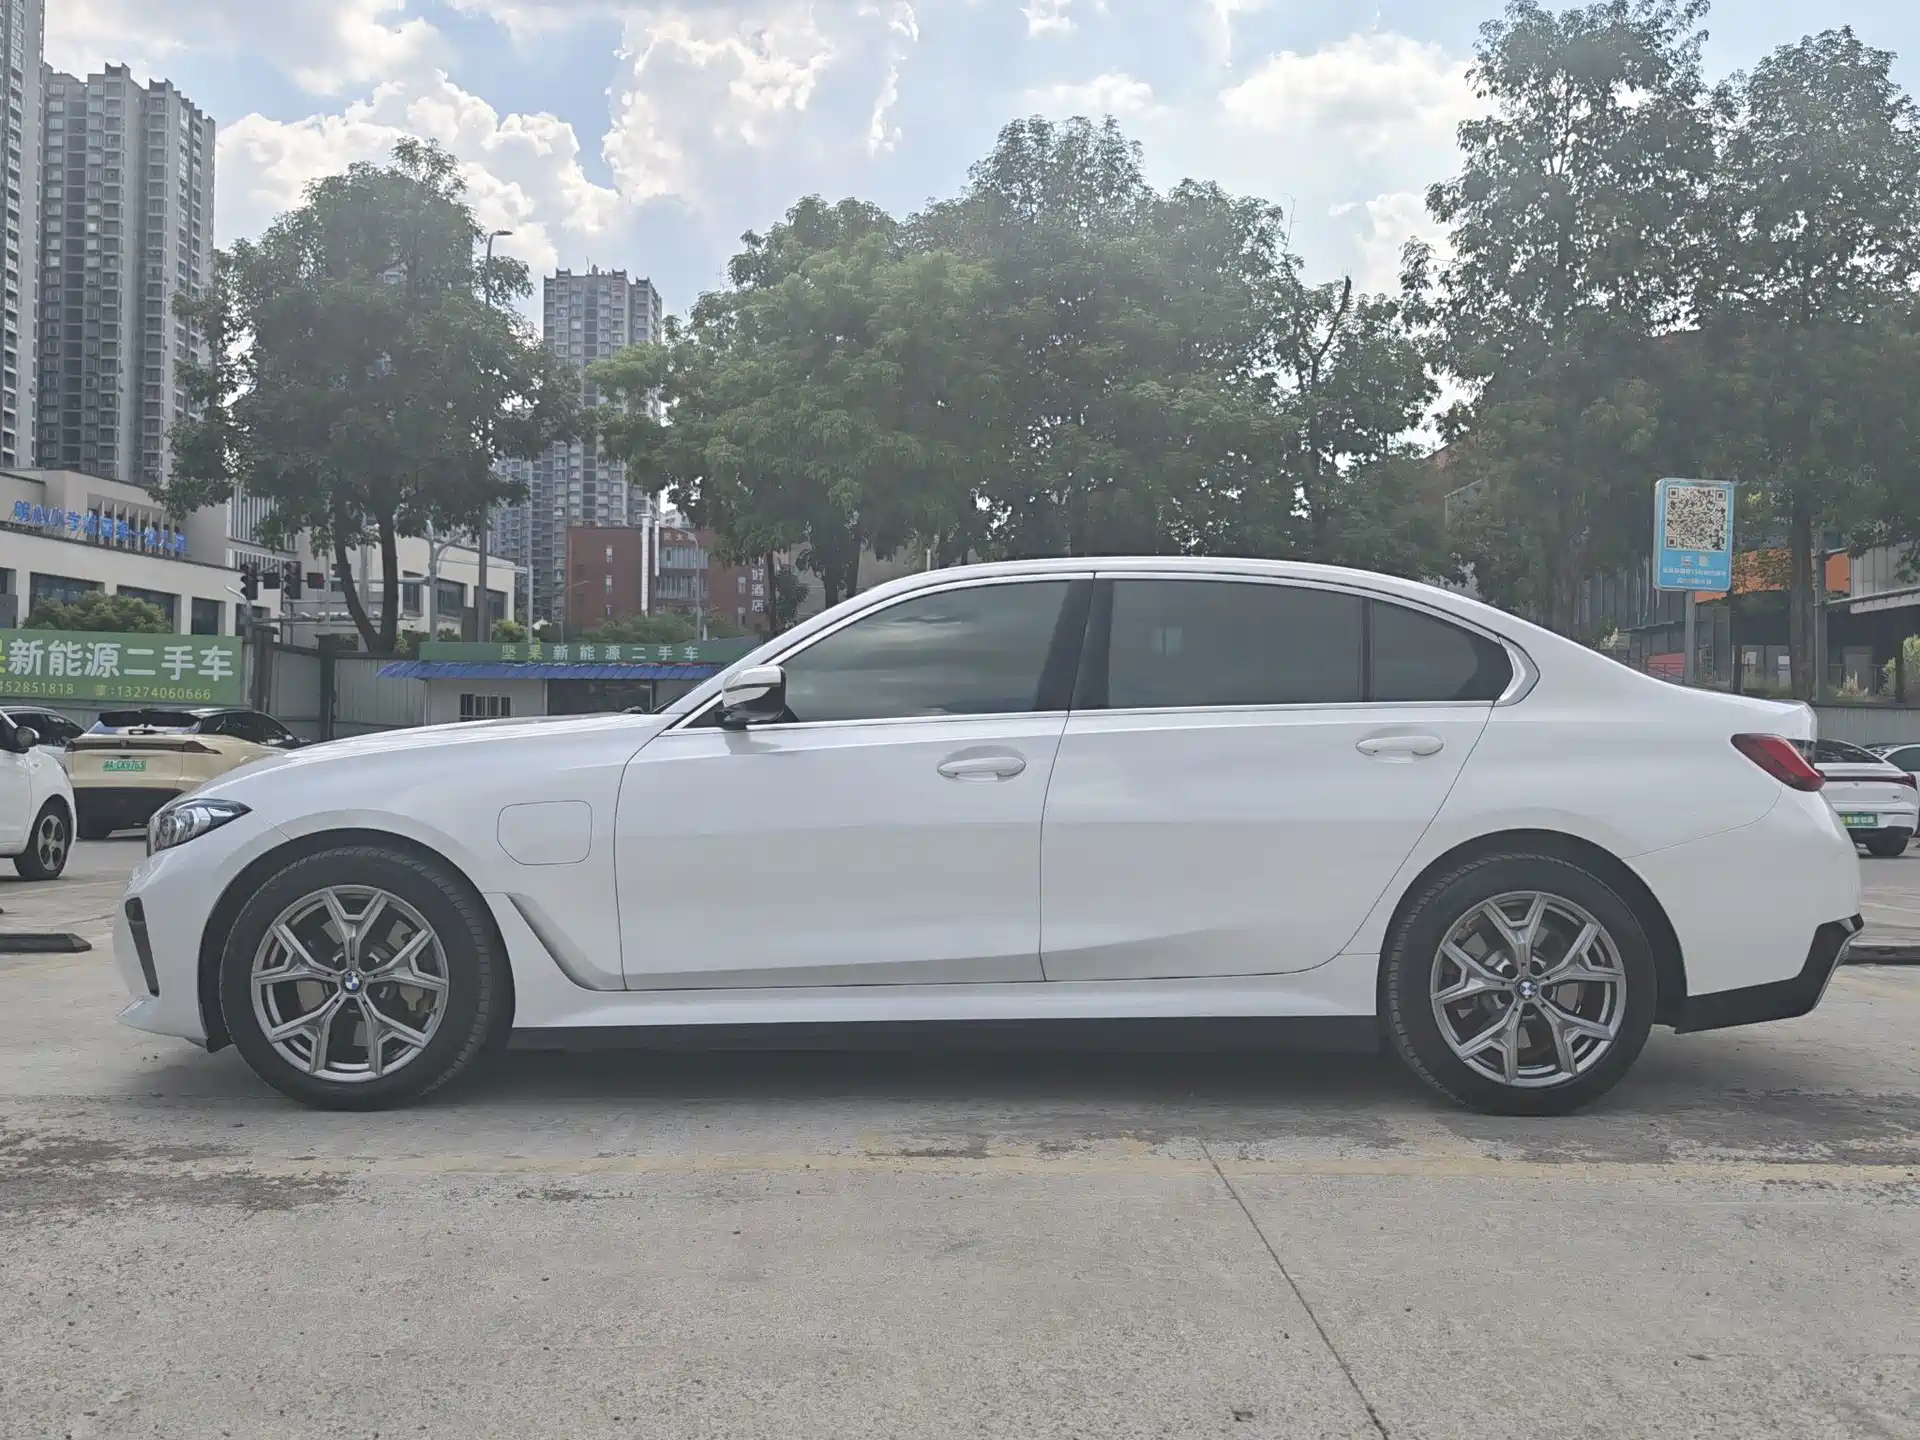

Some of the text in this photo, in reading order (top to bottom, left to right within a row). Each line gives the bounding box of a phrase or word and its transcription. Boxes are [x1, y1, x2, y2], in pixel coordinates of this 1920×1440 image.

[0, 638, 233, 682] 新能源二手车
[501, 644, 701, 661] 坚果新能源二手车
